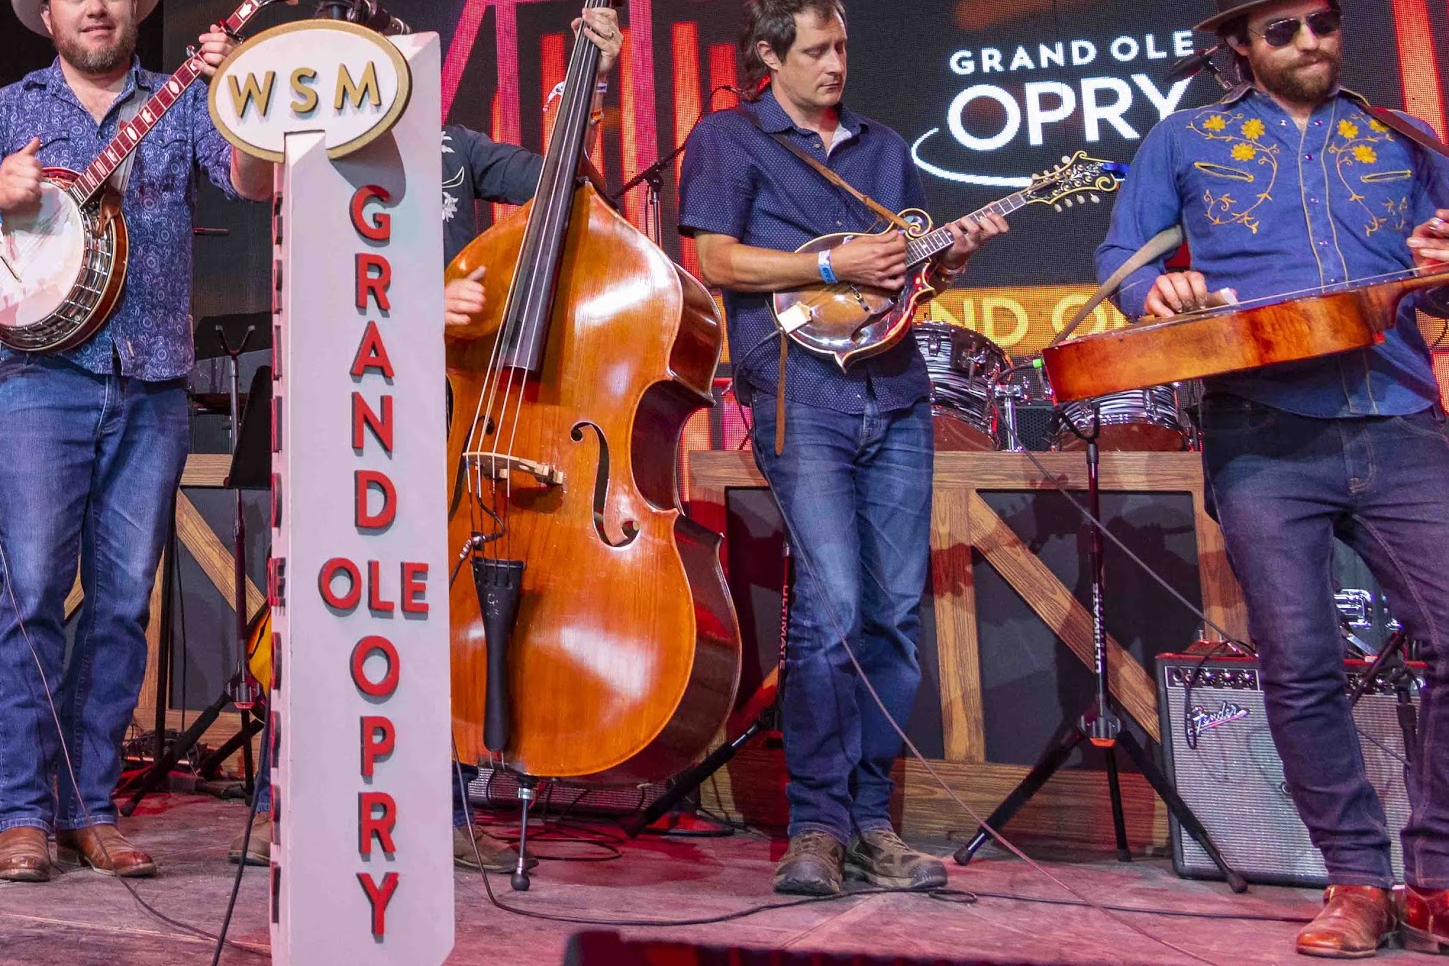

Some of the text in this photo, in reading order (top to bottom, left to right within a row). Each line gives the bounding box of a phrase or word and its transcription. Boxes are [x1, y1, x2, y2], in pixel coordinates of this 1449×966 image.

[227, 60, 382, 119] WSM
[949, 29, 1194, 75] GRAND OLE
[947, 74, 1194, 151] OPRY
[349, 184, 397, 529] GRAND
[318, 557, 429, 613] OLE
[780, 584, 789, 670] ULTIMATE
[1093, 582, 1102, 674] ULTIMATE
[350, 635, 400, 936] OPRY
